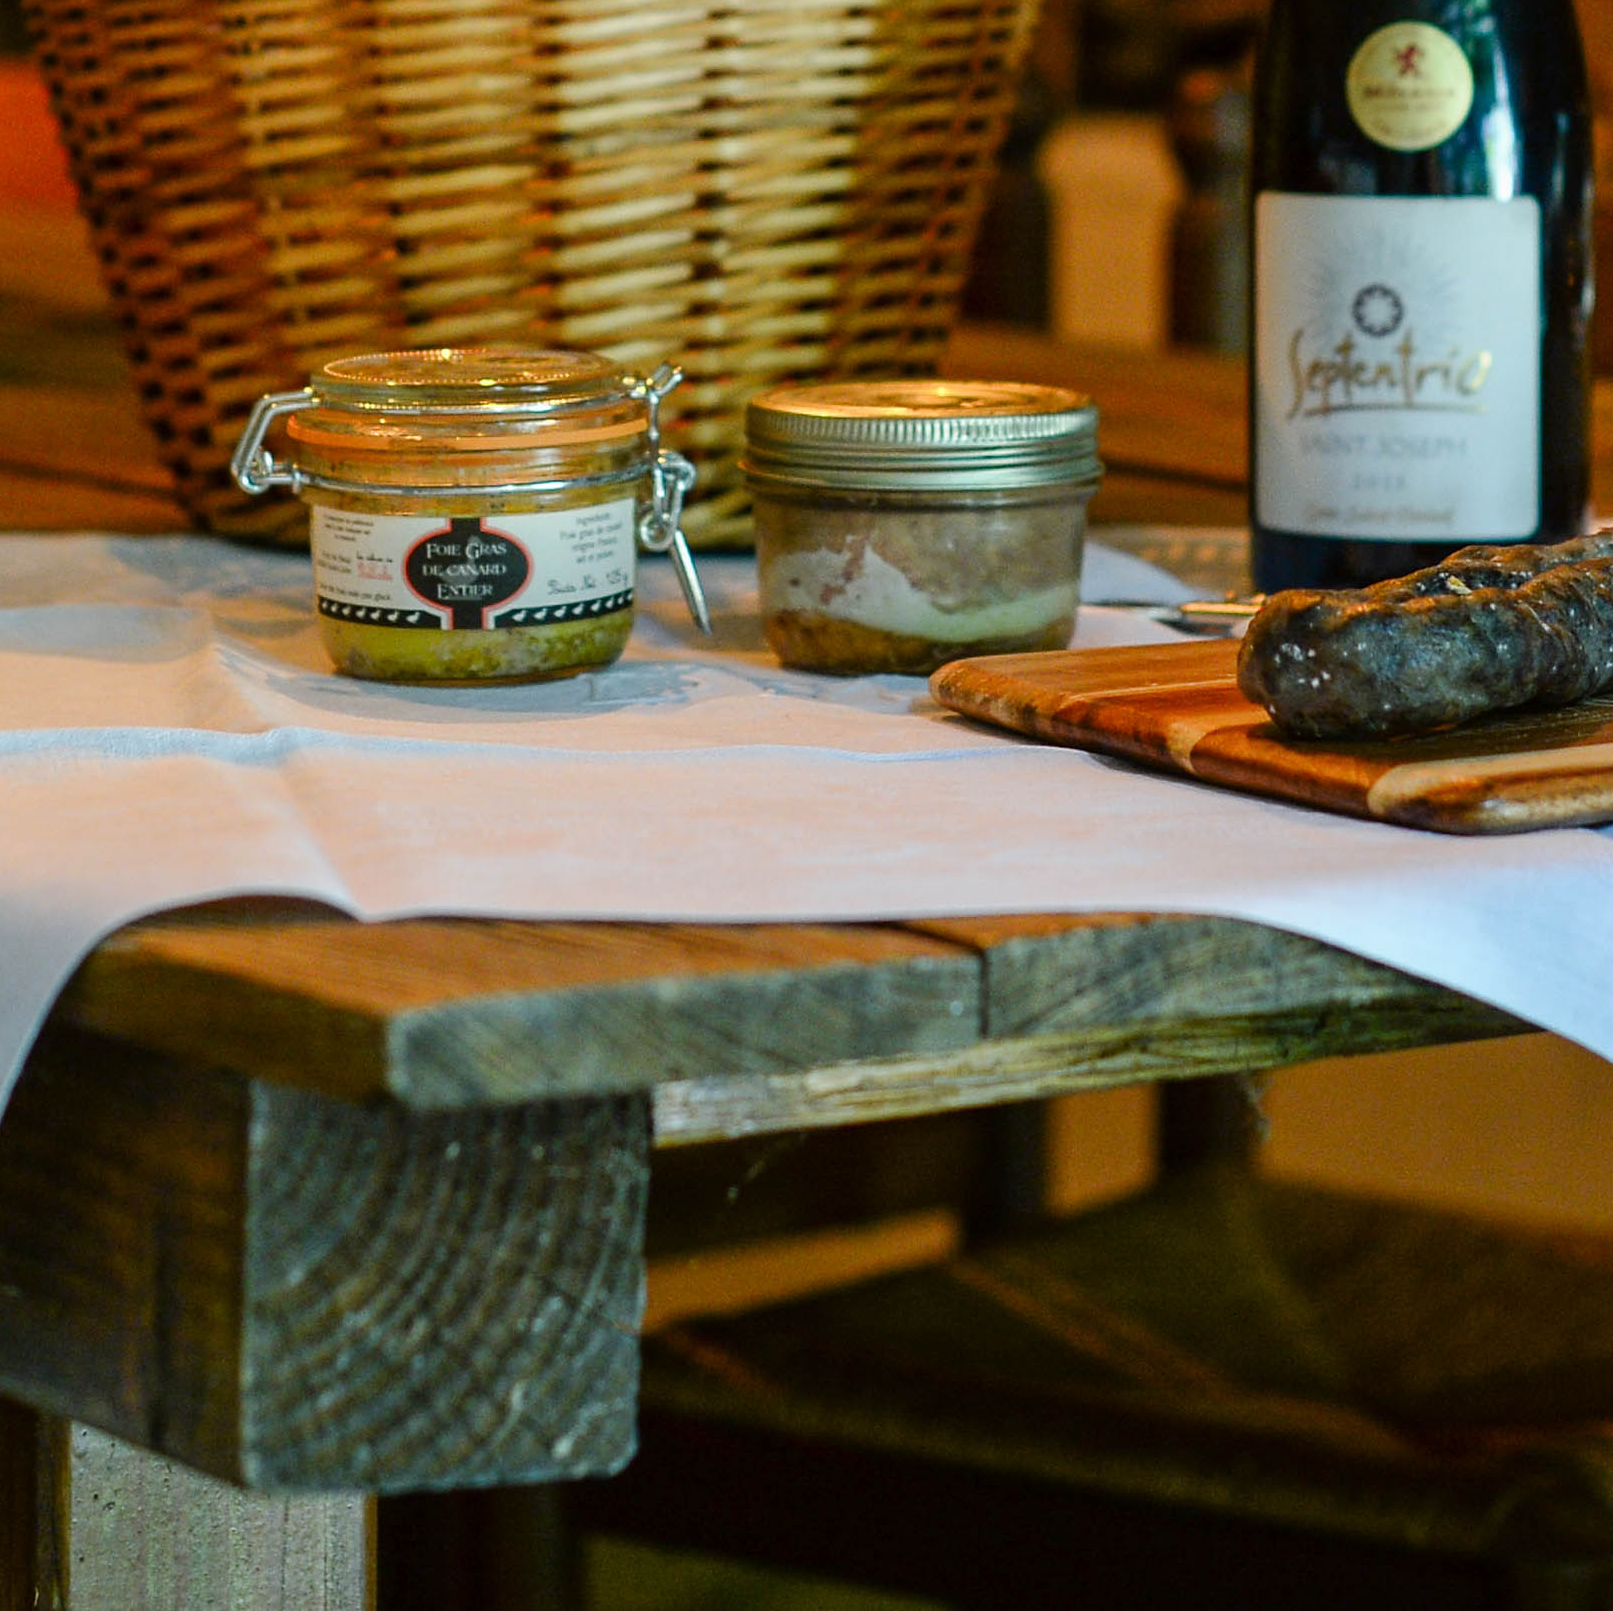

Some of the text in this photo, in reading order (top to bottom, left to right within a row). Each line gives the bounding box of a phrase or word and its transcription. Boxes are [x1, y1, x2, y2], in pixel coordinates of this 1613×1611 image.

[426, 541, 507, 559] FOIE GRAS
[422, 563, 508, 576] DE CANARD
[437, 583, 494, 600] ENTIER
